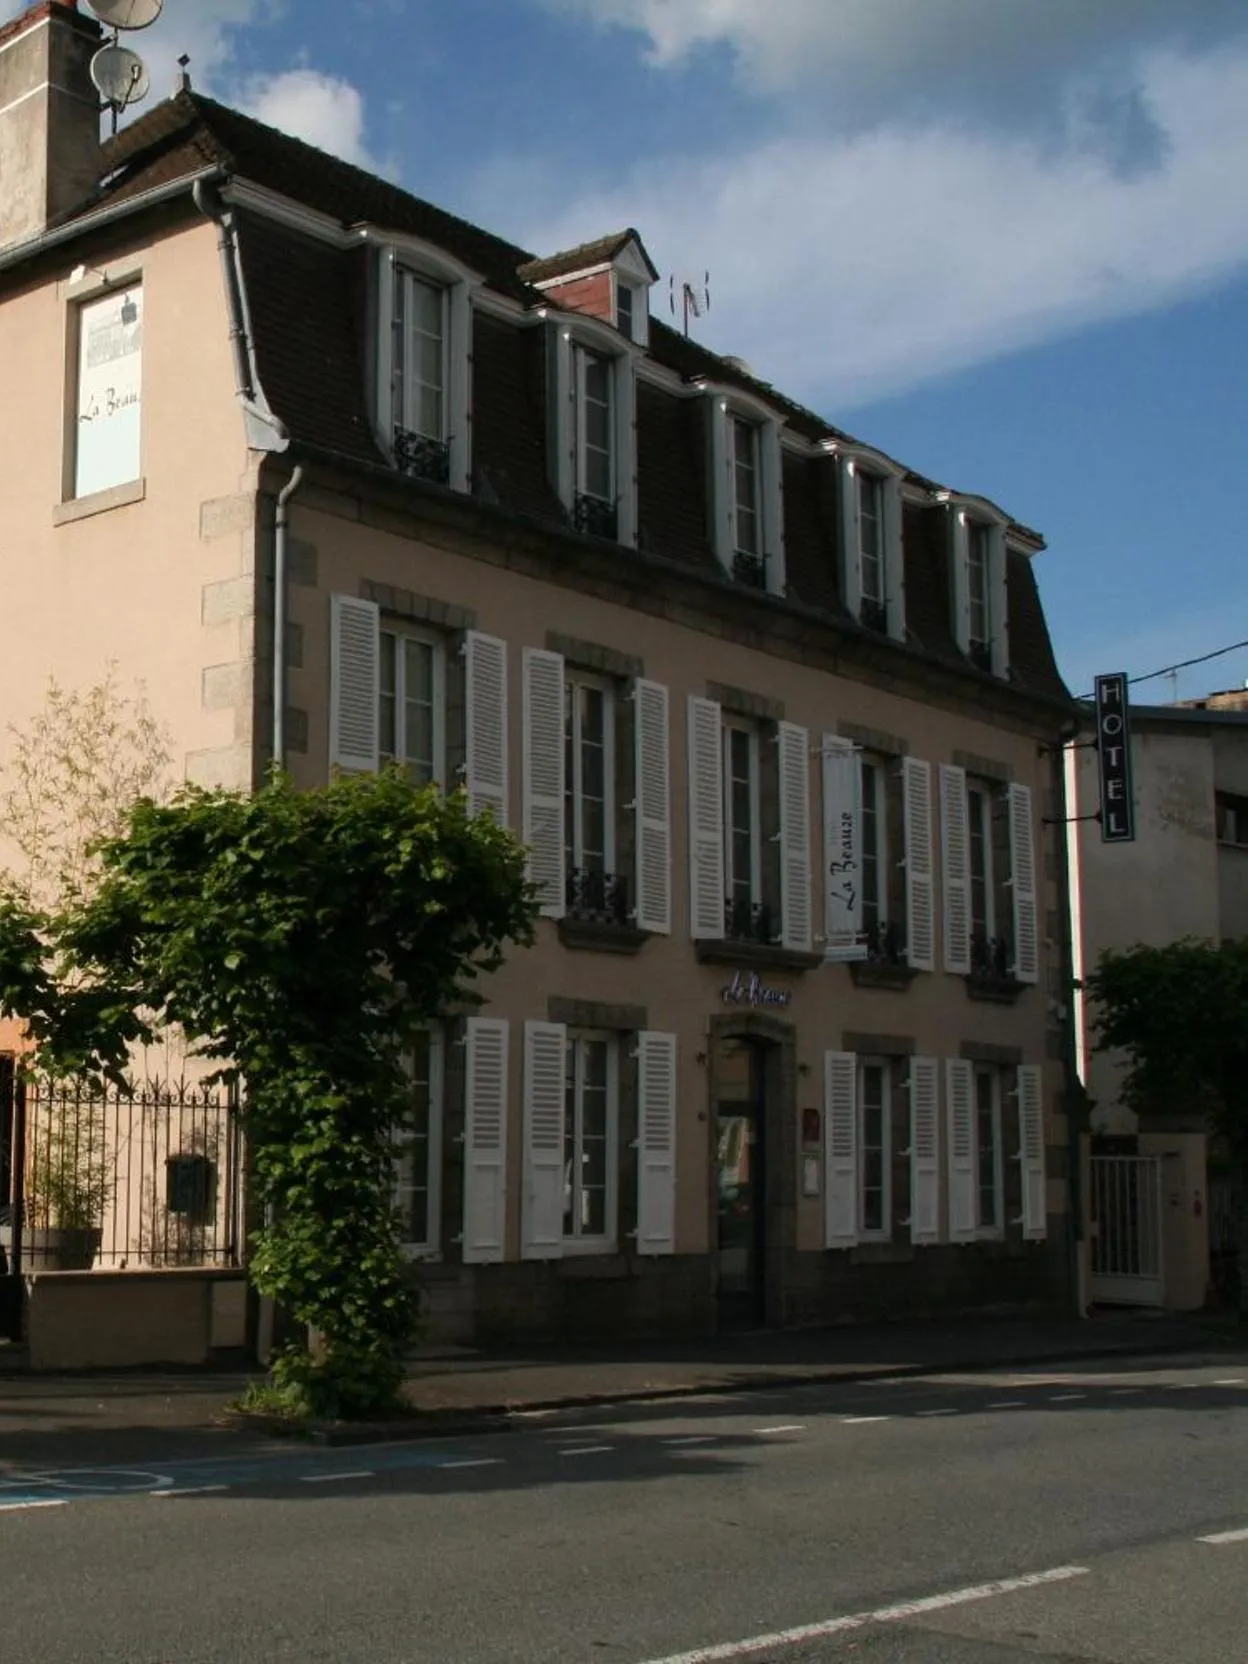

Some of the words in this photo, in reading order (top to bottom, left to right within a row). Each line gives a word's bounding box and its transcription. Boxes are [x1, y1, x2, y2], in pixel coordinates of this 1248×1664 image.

[1101, 683, 1125, 833] HOTEL
[830, 812, 859, 876] Beauze
[830, 880, 856, 912] La
